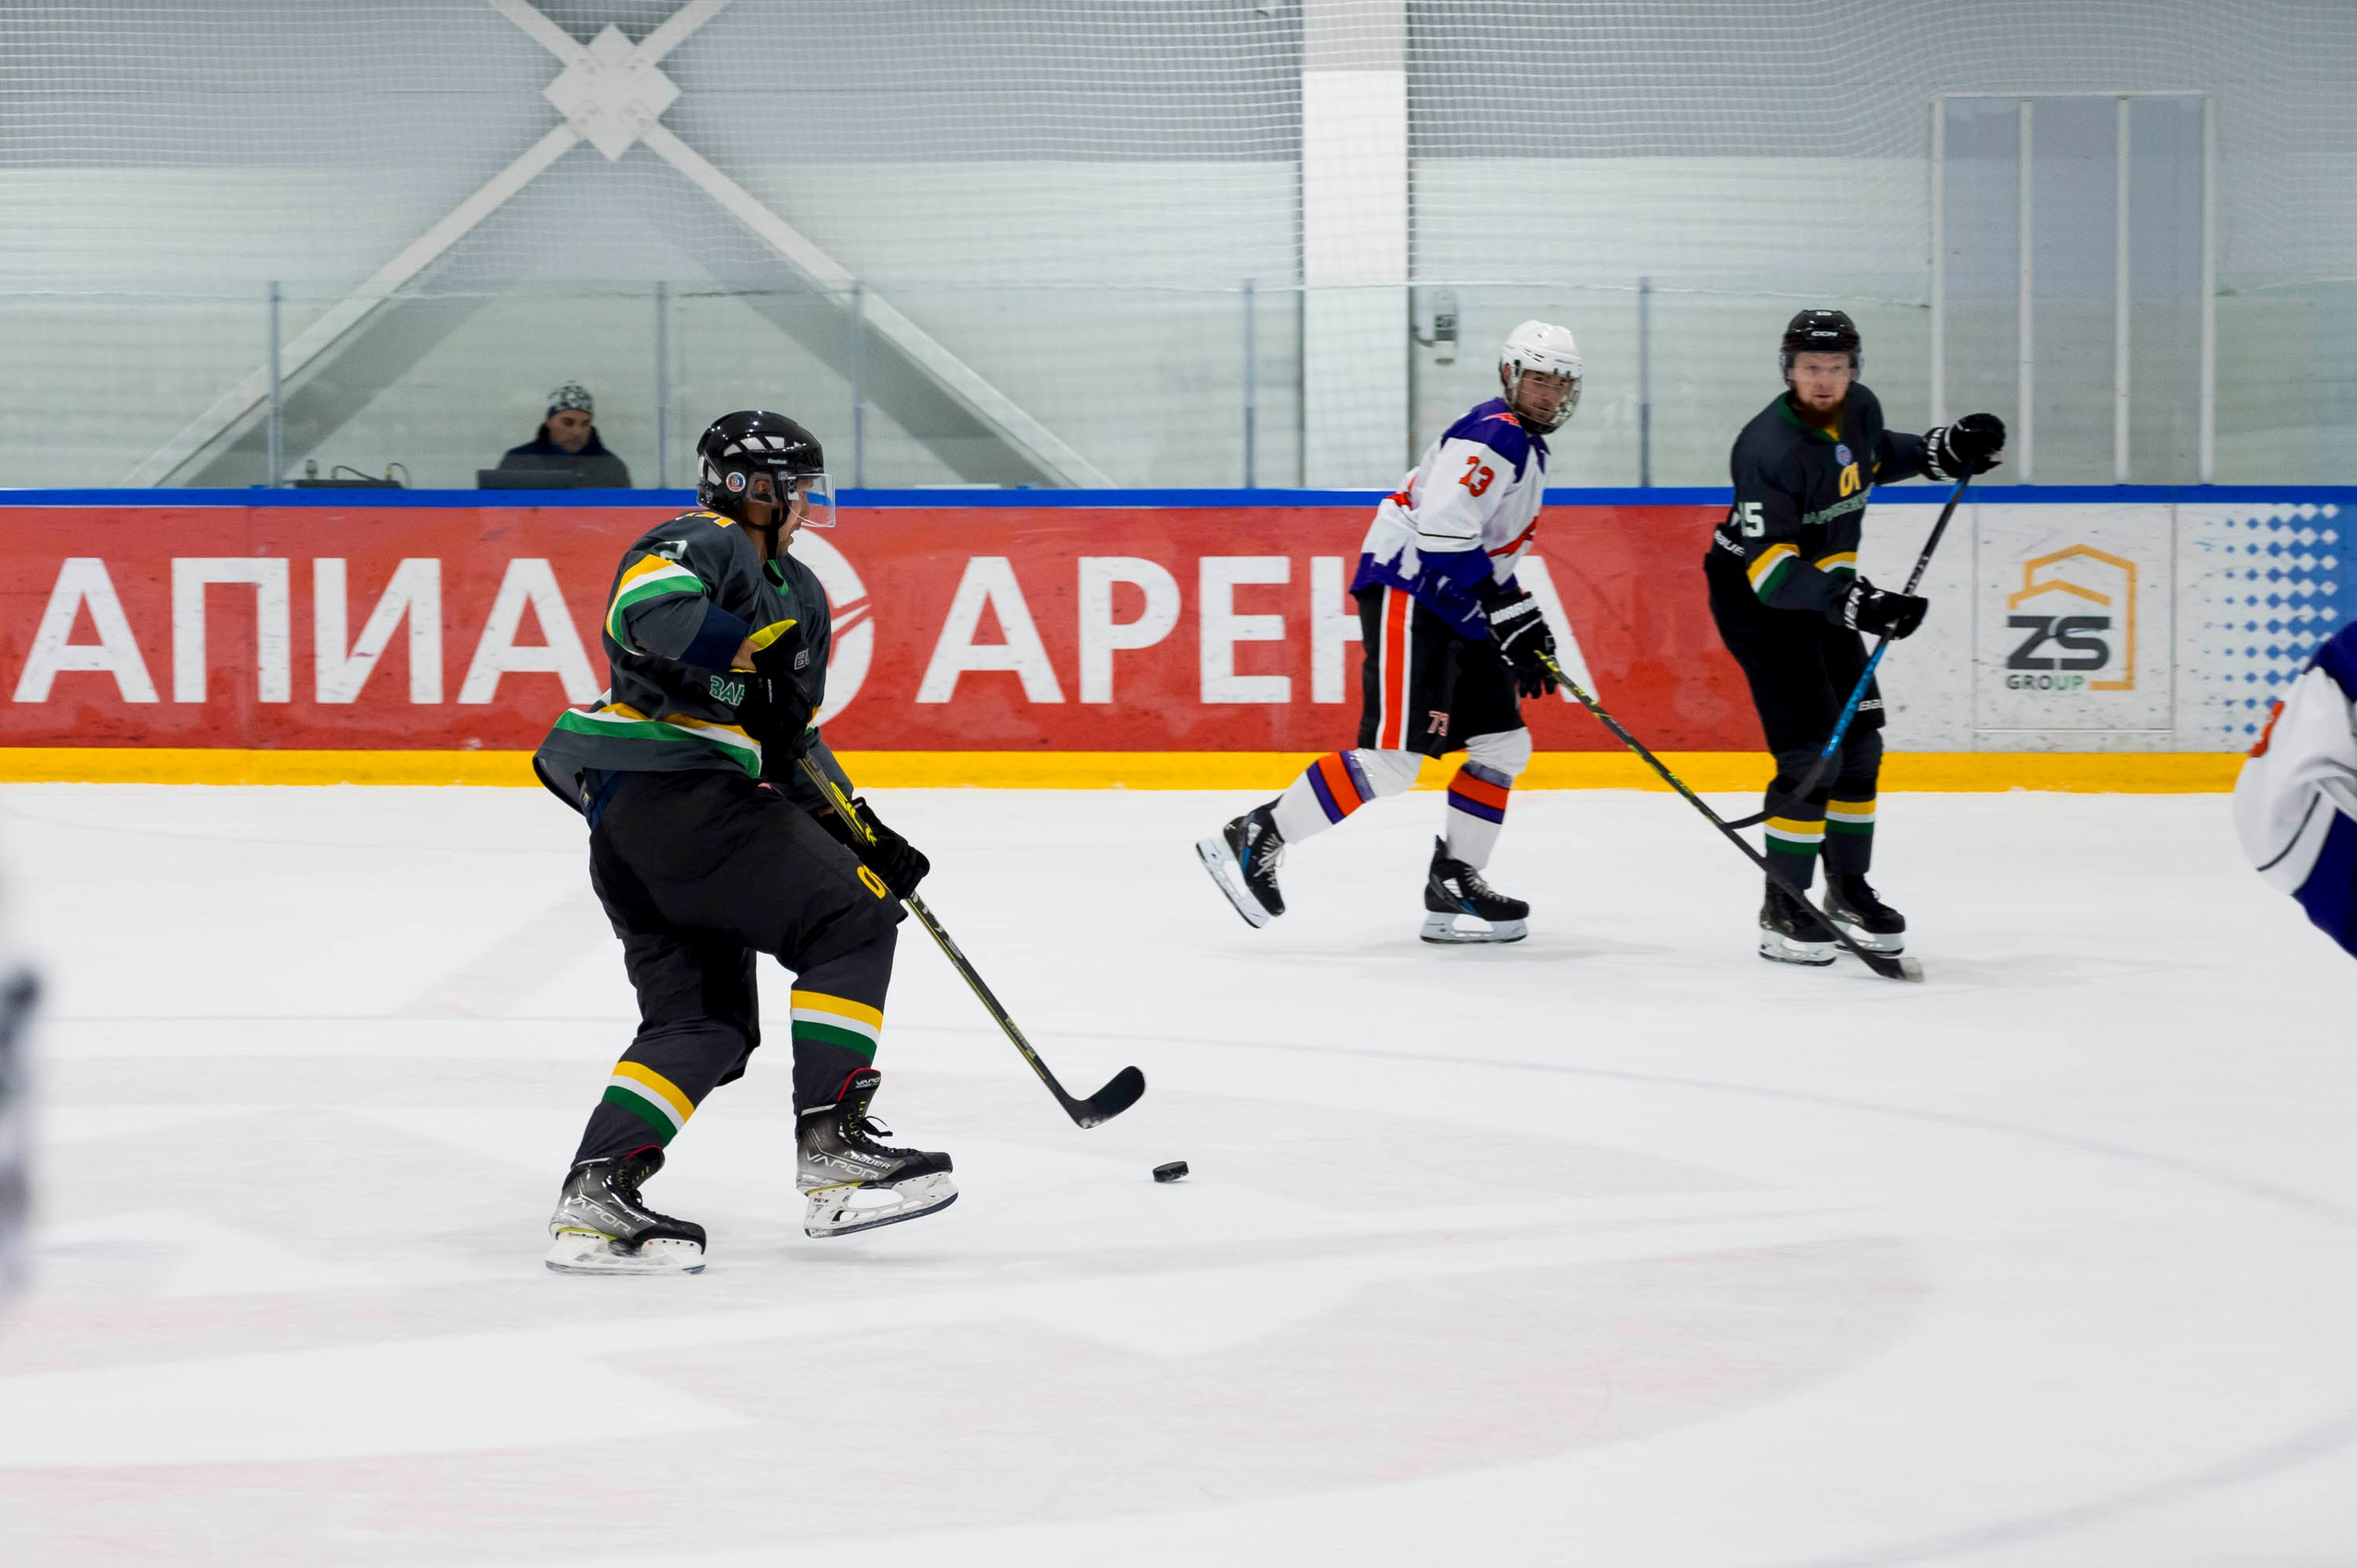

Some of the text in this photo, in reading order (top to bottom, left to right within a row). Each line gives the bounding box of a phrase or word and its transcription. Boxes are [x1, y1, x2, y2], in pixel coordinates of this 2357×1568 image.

[2007, 615, 2111, 671] ZS
[2006, 674, 2084, 691] GROUP
[1426, 710, 1449, 737] 73
[806, 1149, 880, 1181] VAPOR
[850, 1154, 891, 1169] BAUER
